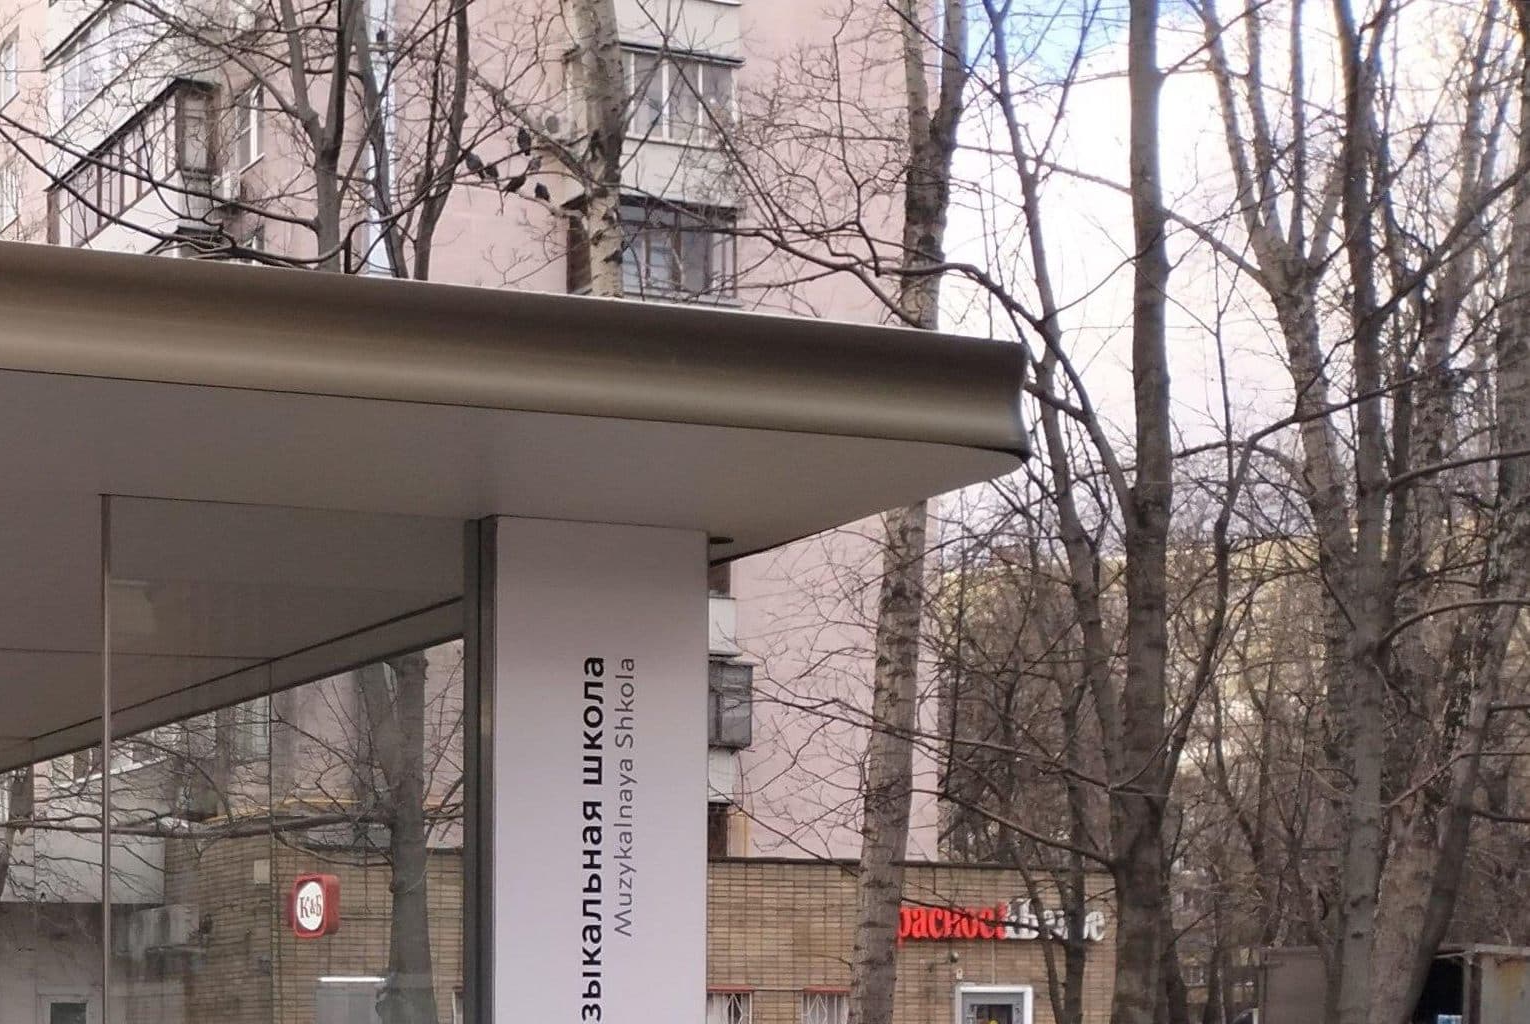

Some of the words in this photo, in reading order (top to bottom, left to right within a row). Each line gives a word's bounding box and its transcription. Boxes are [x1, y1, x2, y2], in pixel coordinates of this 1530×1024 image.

[582, 656, 605, 786] школа
[614, 657, 635, 748] Shkola
[613, 758, 638, 938] Muzykalnaya
